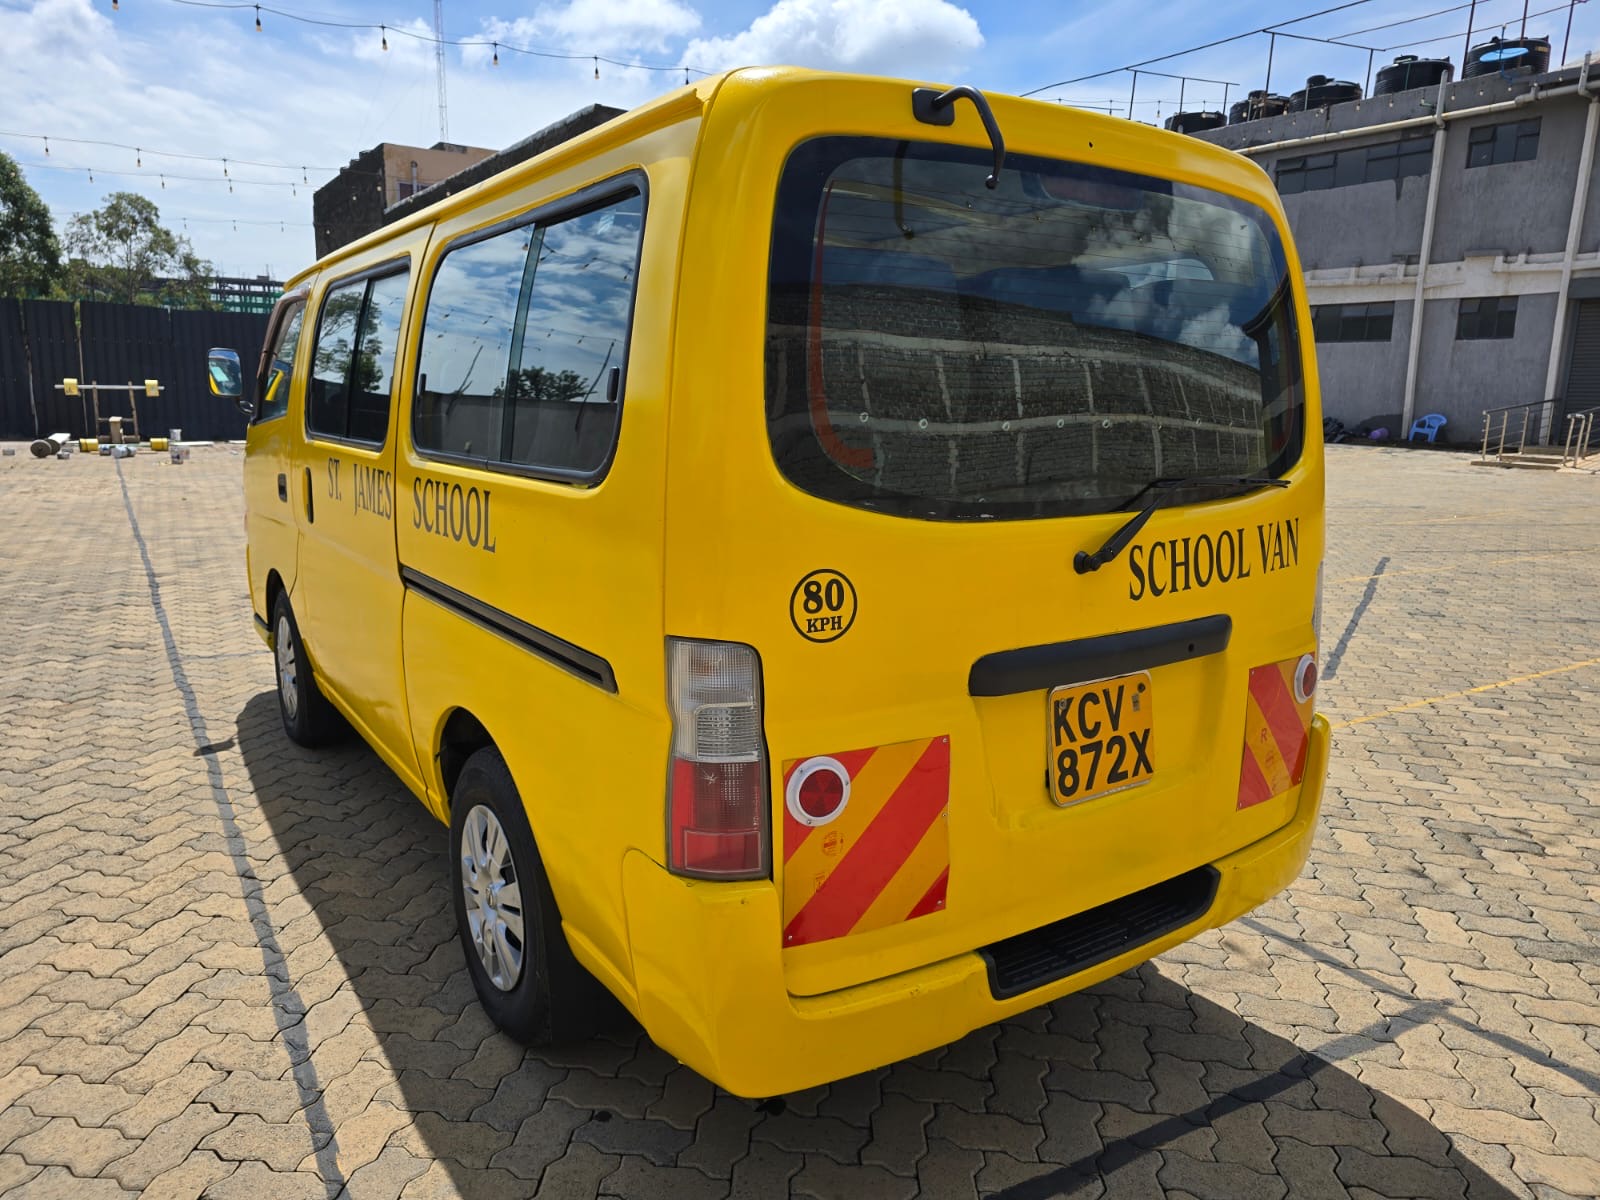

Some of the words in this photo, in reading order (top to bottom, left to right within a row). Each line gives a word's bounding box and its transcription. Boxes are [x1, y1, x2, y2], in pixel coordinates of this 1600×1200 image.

[353, 463, 392, 520] JAMES
[413, 476, 496, 553] SCHOOL
[1129, 528, 1251, 601] SCHOOL
[1257, 518, 1299, 574] VAN
[803, 578, 845, 614] 80
[806, 615, 843, 633] KPH
[1053, 685, 1124, 747] KCV
[1057, 728, 1154, 797] 872X
